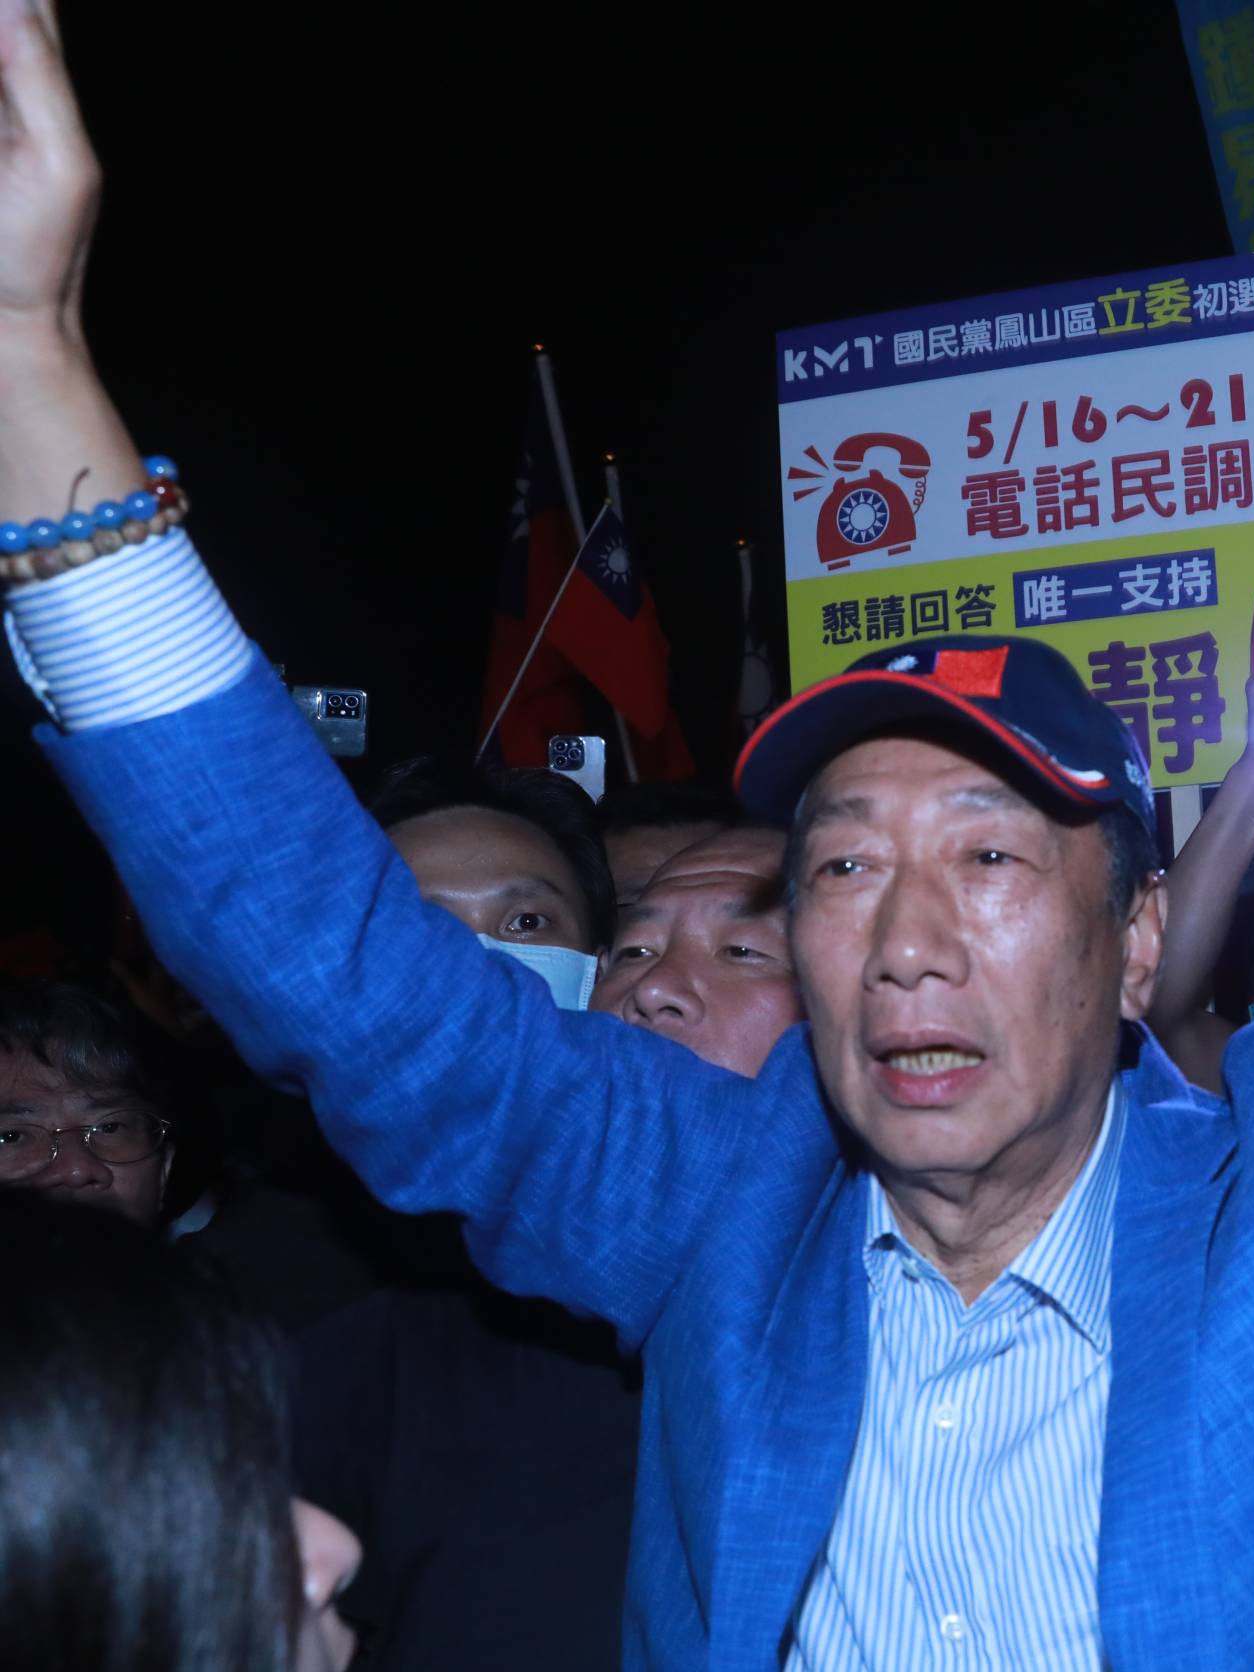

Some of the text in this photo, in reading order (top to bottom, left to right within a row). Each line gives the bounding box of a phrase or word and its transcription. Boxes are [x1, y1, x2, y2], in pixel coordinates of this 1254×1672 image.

[784, 336, 884, 382] KMT
[820, 557, 1214, 646] 懇請回答 唯一支持
